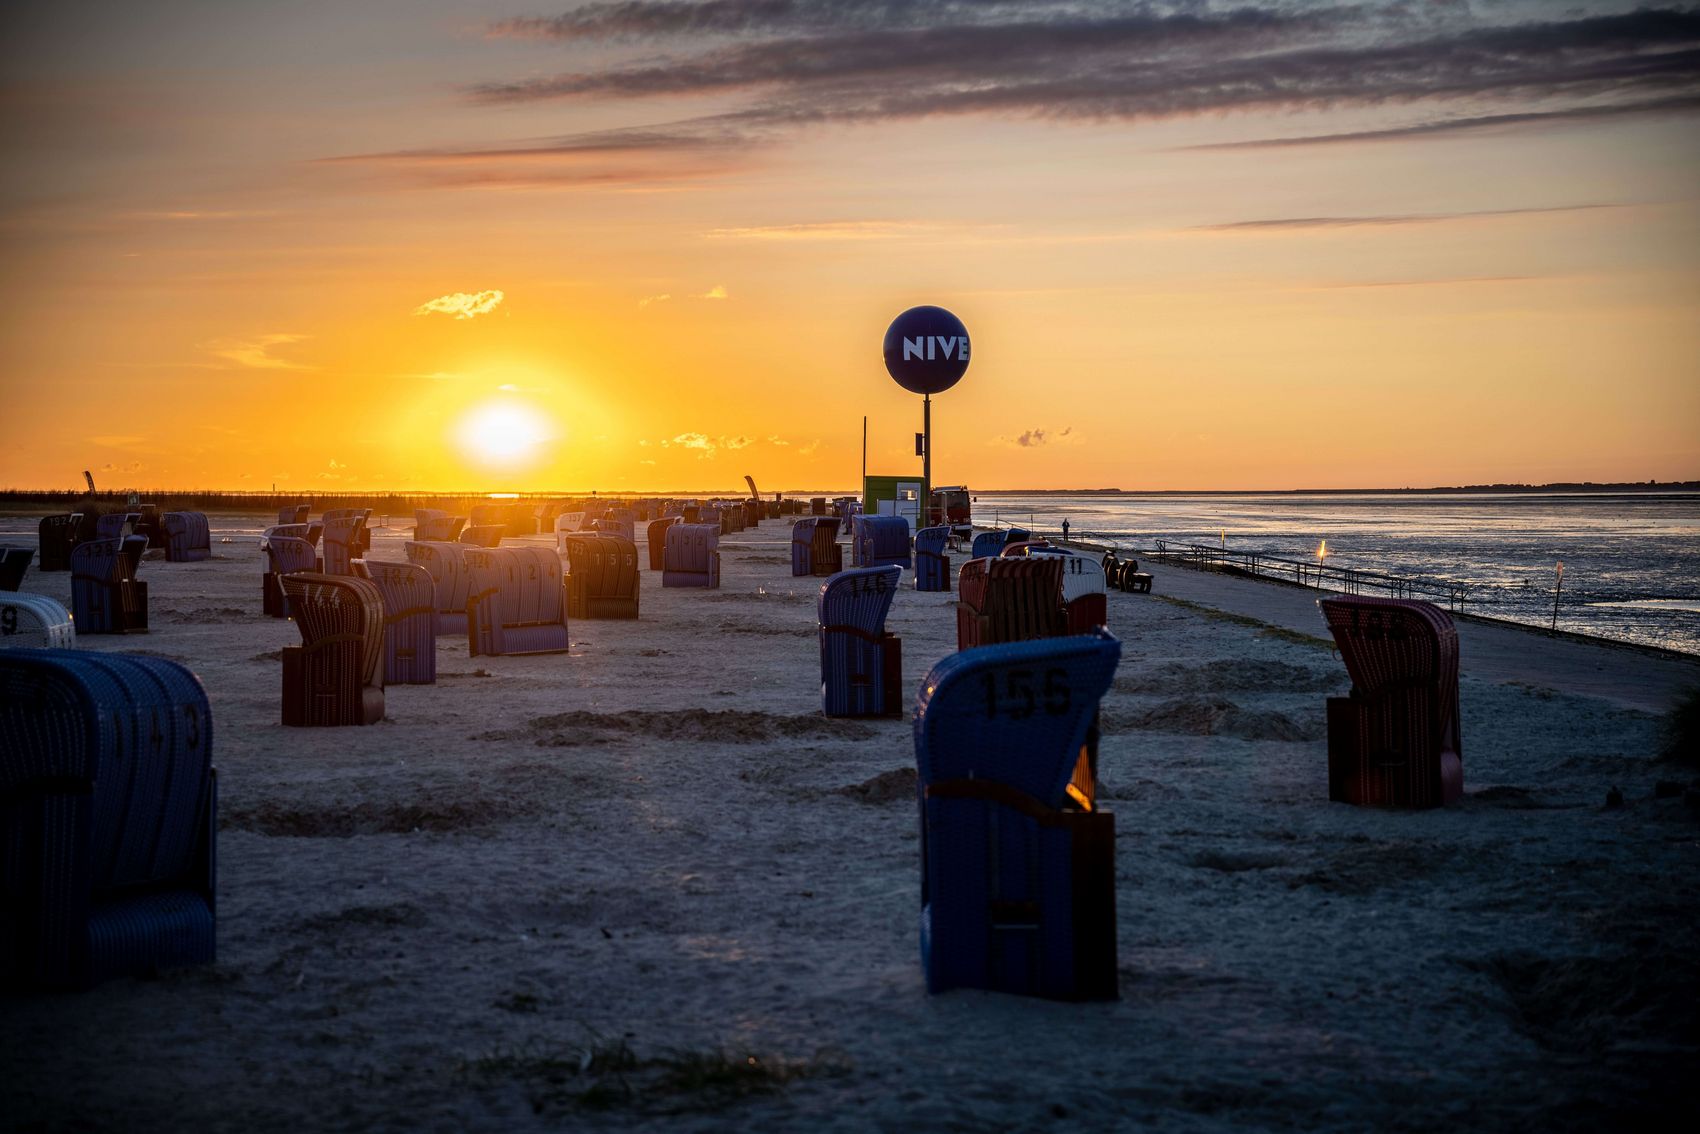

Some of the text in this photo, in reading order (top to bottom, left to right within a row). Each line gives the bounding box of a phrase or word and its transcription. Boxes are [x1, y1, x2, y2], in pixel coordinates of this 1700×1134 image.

[672, 535, 703, 545] 132
[281, 541, 303, 554] 148
[1070, 559, 1082, 573] 11
[852, 574, 886, 597] 146
[984, 668, 1071, 719] 156
